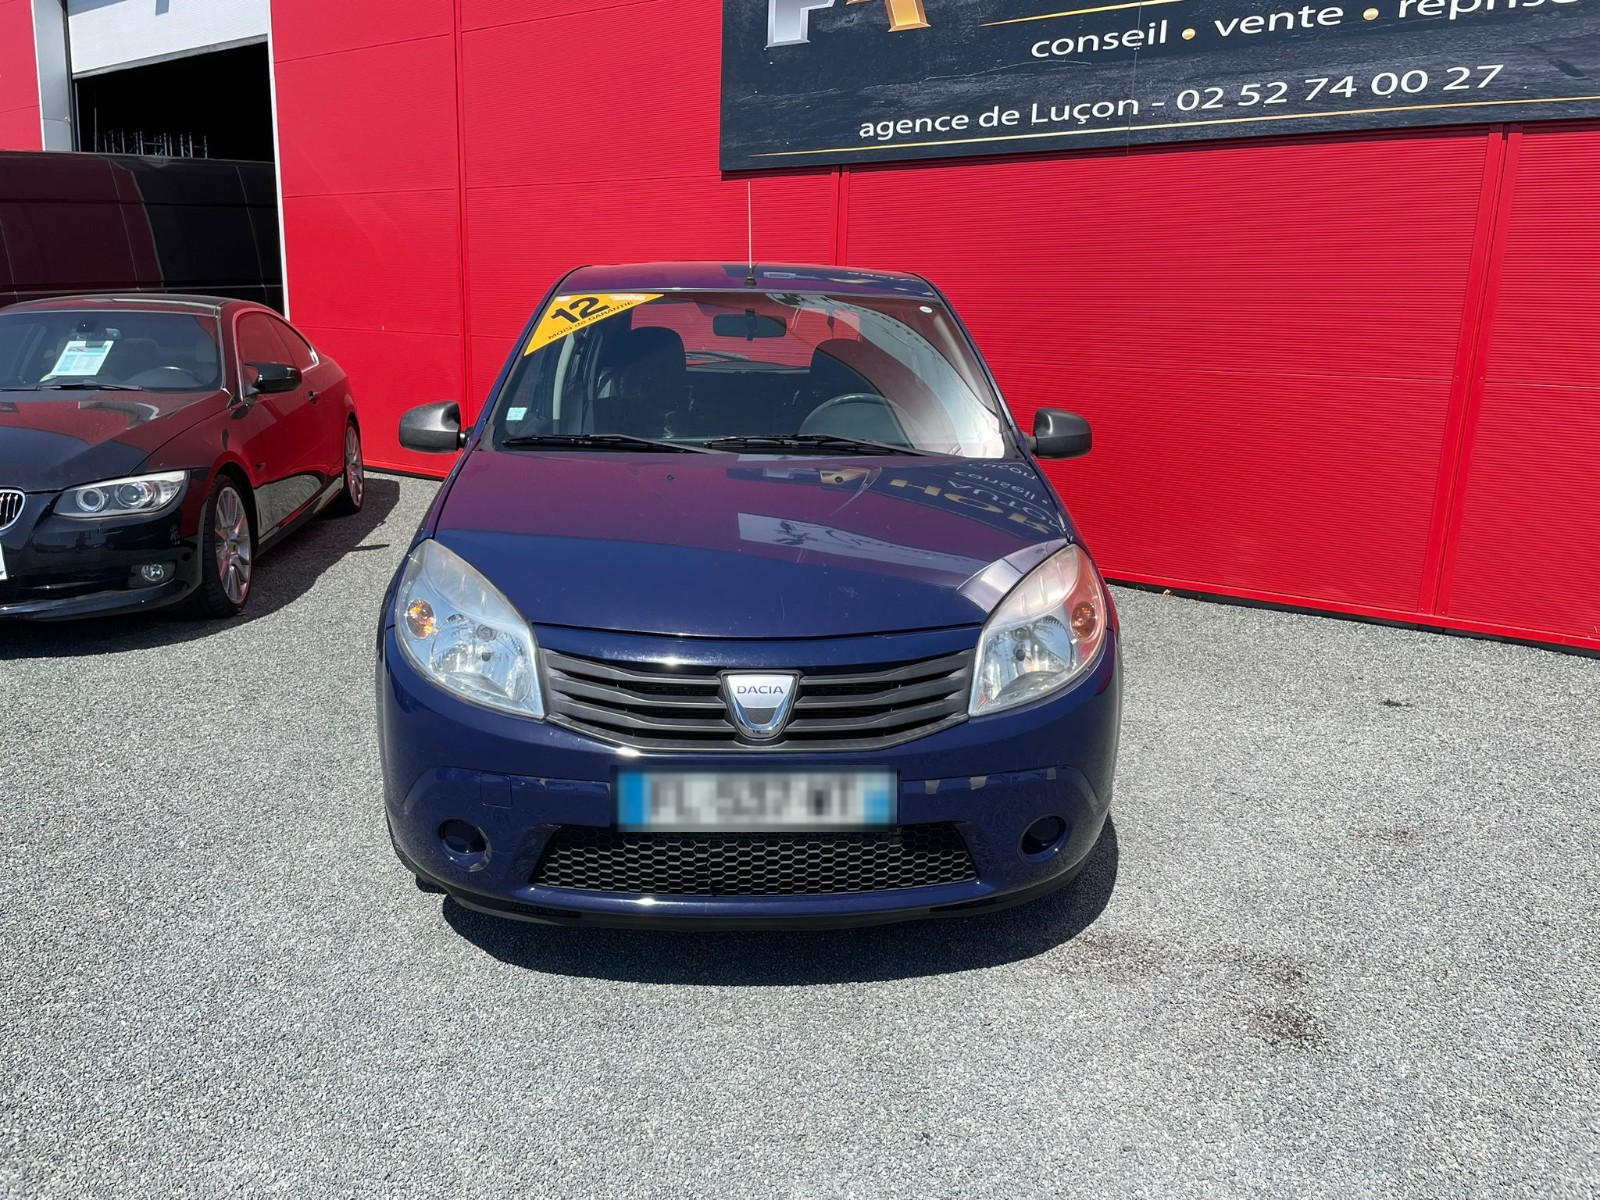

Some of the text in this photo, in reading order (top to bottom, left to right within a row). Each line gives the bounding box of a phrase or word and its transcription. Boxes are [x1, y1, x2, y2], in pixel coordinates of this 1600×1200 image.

[1031, 0, 1579, 58] conseil vente repr
[858, 113, 969, 141] agence
[978, 105, 1020, 128] de
[1031, 98, 1139, 126] Luçon
[1176, 87, 1224, 111] 02
[1237, 81, 1288, 106] 52
[1304, 75, 1358, 101] 74
[1370, 69, 1429, 96] 00
[1442, 64, 1504, 91] 27
[550, 296, 610, 324] 12
[587, 300, 634, 323] GARANTIE
[737, 686, 784, 695] DACIA
